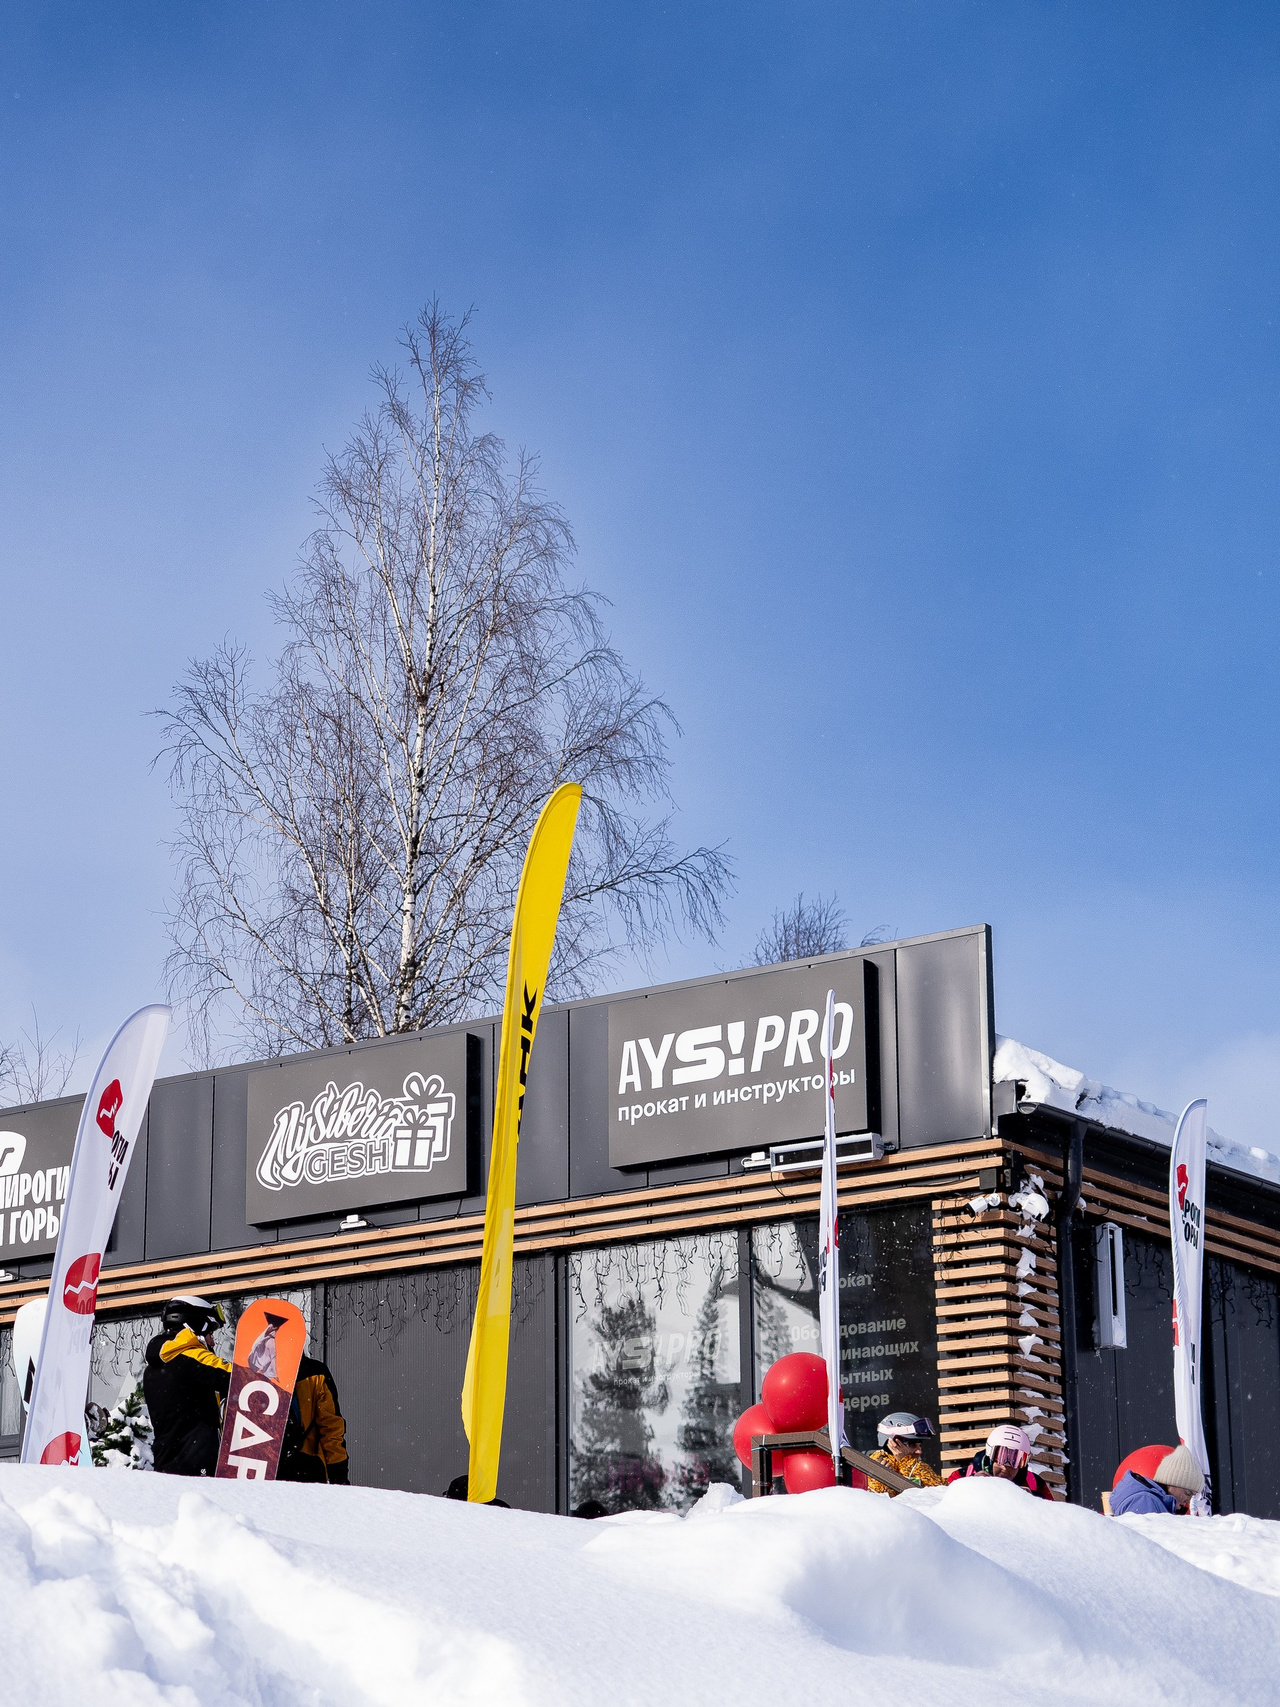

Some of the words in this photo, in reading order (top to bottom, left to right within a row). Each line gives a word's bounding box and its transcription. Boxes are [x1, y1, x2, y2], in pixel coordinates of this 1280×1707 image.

[618, 1003, 854, 1094] AYS!PRO
[618, 1095, 690, 1126] прокат
[694, 1091, 707, 1109] и
[305, 1138, 392, 1184] GESH
[838, 1273, 874, 1289] окат
[791, 1317, 907, 1342] Ободование
[839, 1341, 920, 1360] инающих
[839, 1368, 894, 1385] ытных
